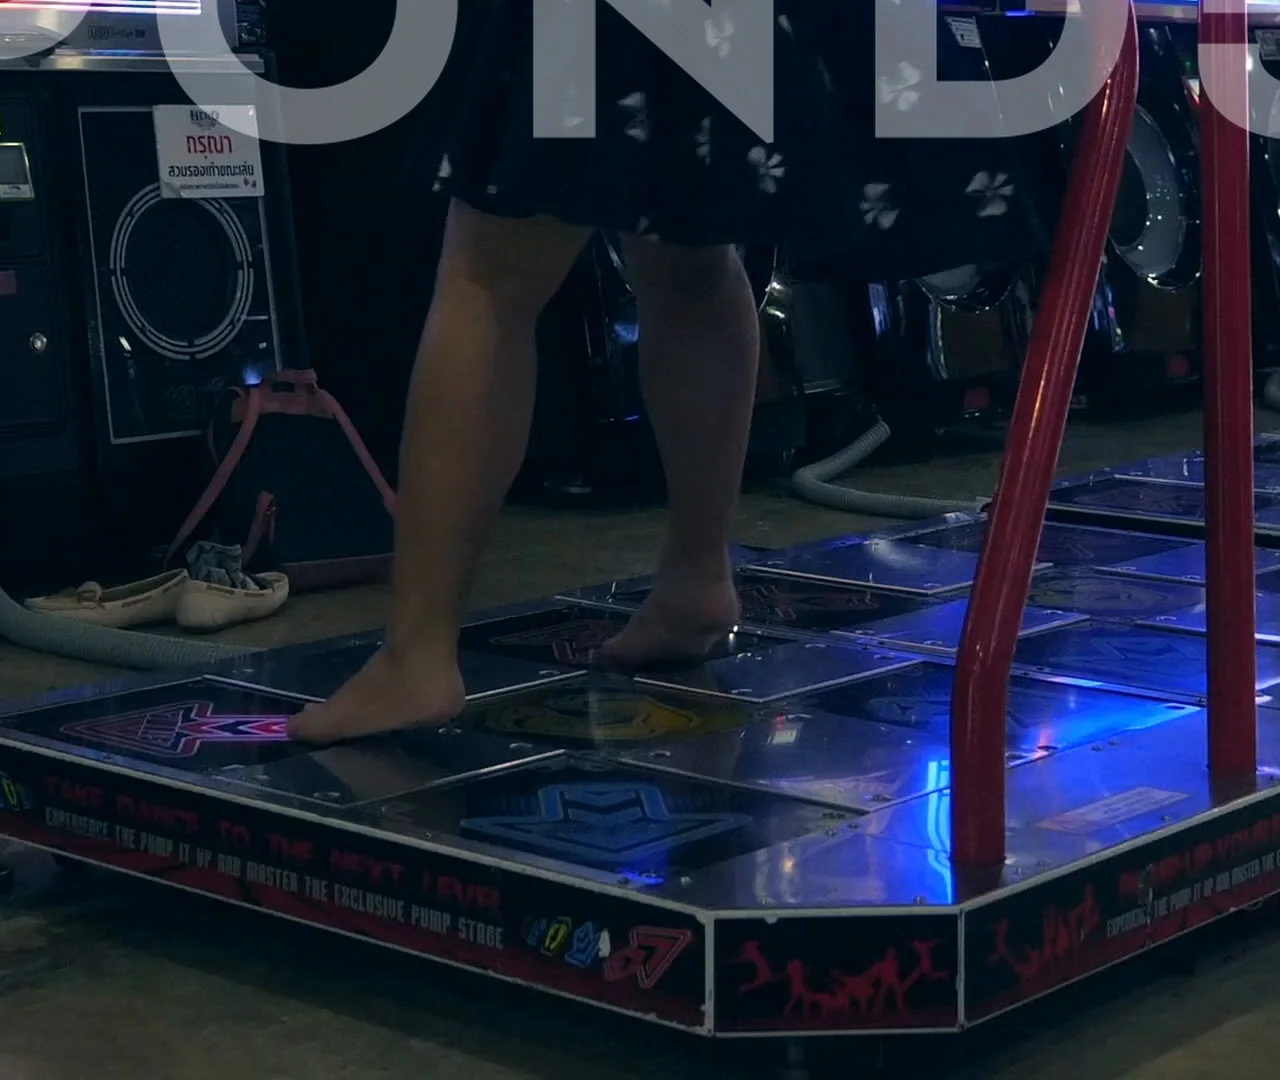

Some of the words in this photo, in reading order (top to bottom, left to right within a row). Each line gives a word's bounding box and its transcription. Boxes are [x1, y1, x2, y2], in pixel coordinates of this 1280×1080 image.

[186, 135, 232, 160] กรุณา
[115, 824, 136, 851] THE
[140, 831, 175, 858] PUMP
[179, 841, 191, 864] IT
[196, 846, 213, 869] UP
[216, 853, 241, 877] AND
[246, 860, 299, 893] MASTER
[304, 875, 329, 902] THE
[333, 883, 406, 922] EXCLUSIVE
[410, 904, 452, 935] PUMP
[458, 921, 505, 950] STAGE
